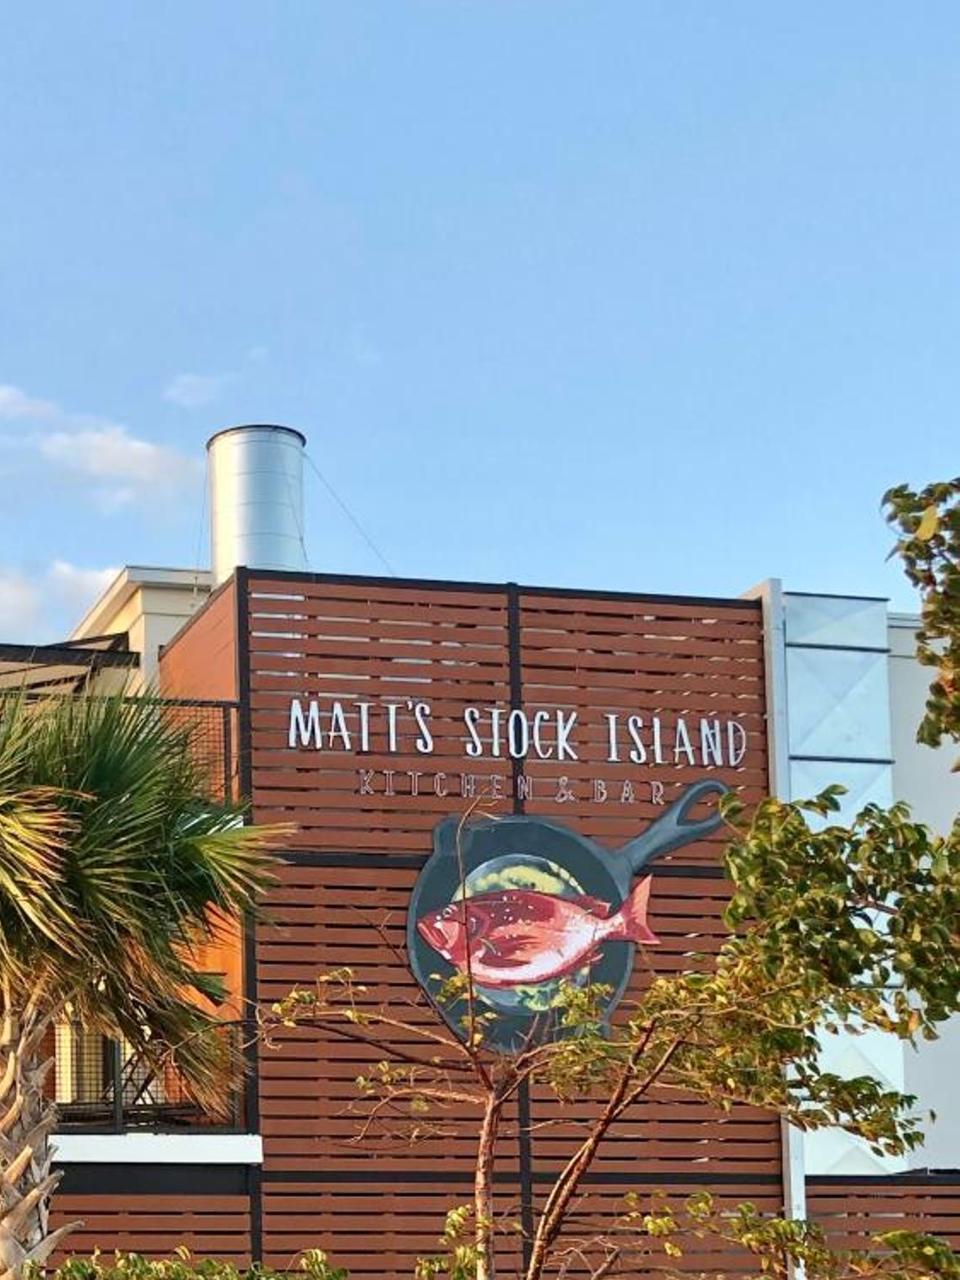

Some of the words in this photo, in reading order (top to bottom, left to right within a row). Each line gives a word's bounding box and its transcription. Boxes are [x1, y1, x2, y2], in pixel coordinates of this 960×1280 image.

[288, 698, 434, 754] MATT'S
[463, 706, 578, 761] STOCK
[605, 713, 747, 767] ISLAND
[359, 768, 533, 801] KITCHEN
[555, 779, 577, 804] &
[593, 779, 666, 806] BAR
